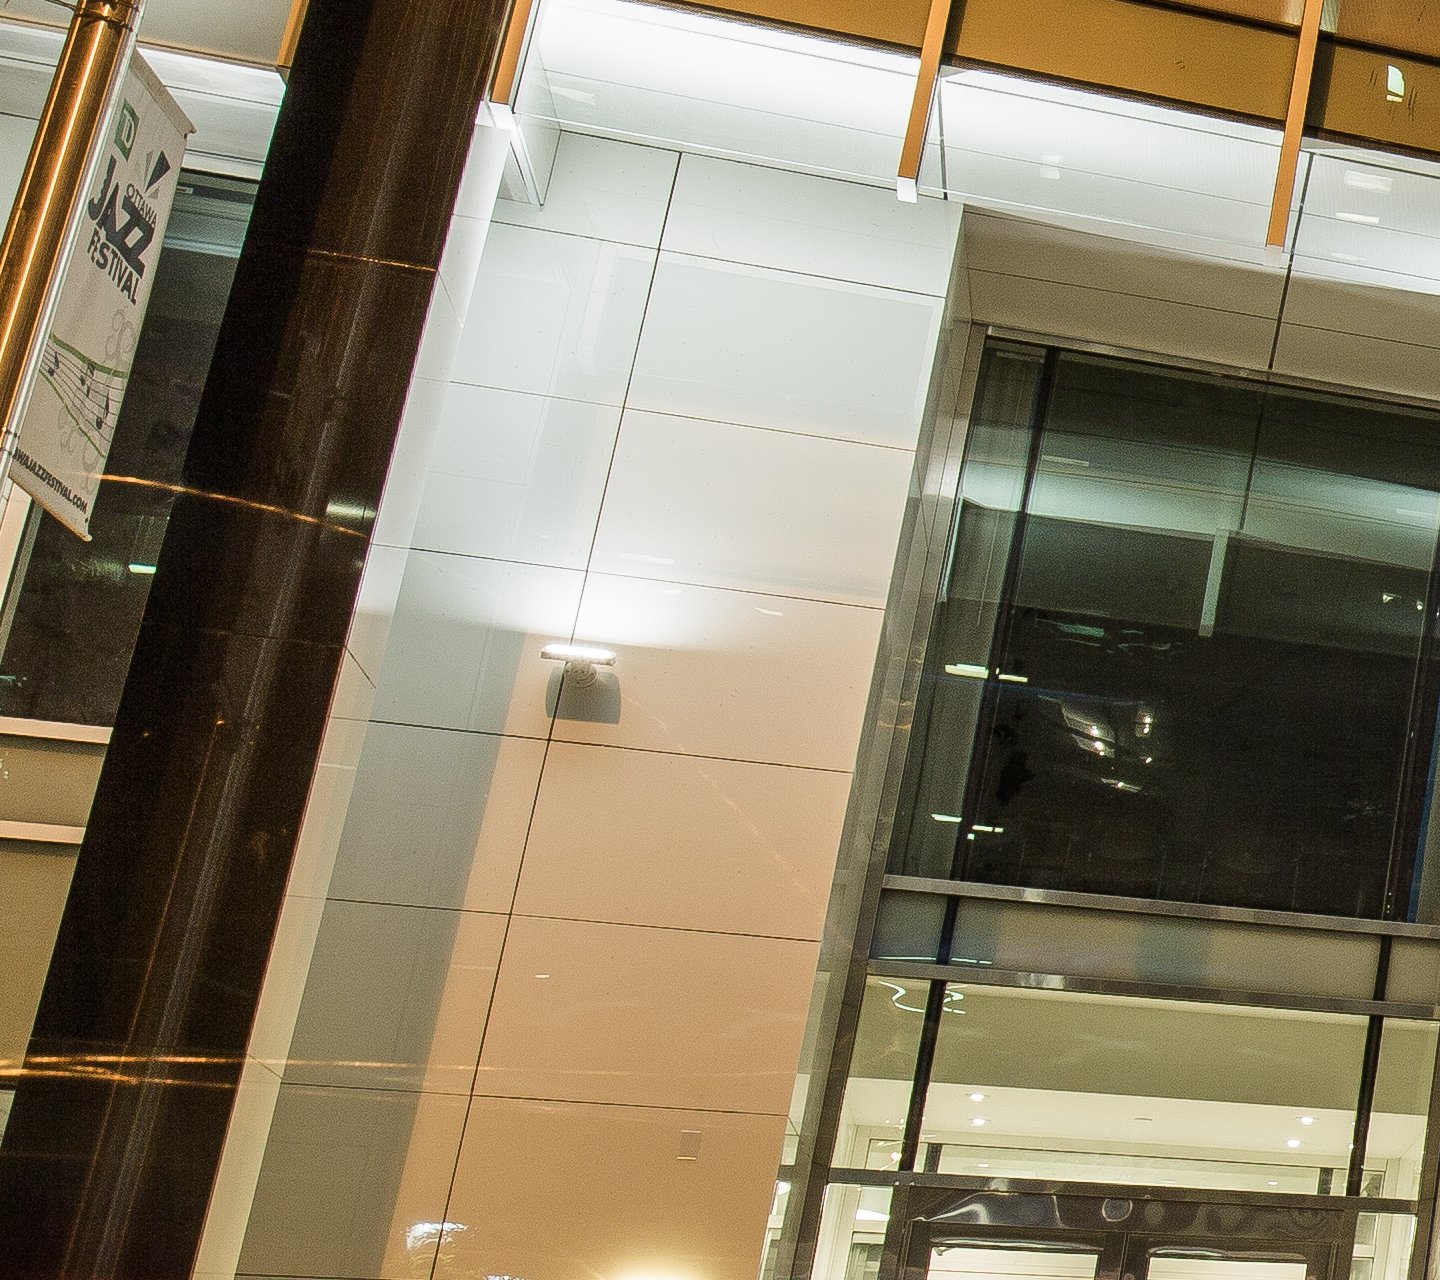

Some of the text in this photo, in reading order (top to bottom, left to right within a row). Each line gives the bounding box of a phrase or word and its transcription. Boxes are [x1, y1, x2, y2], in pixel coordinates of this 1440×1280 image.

[88, 155, 154, 279] JAZZ
[125, 182, 158, 229] OTTAWA
[87, 227, 142, 306] FESTIVAL
